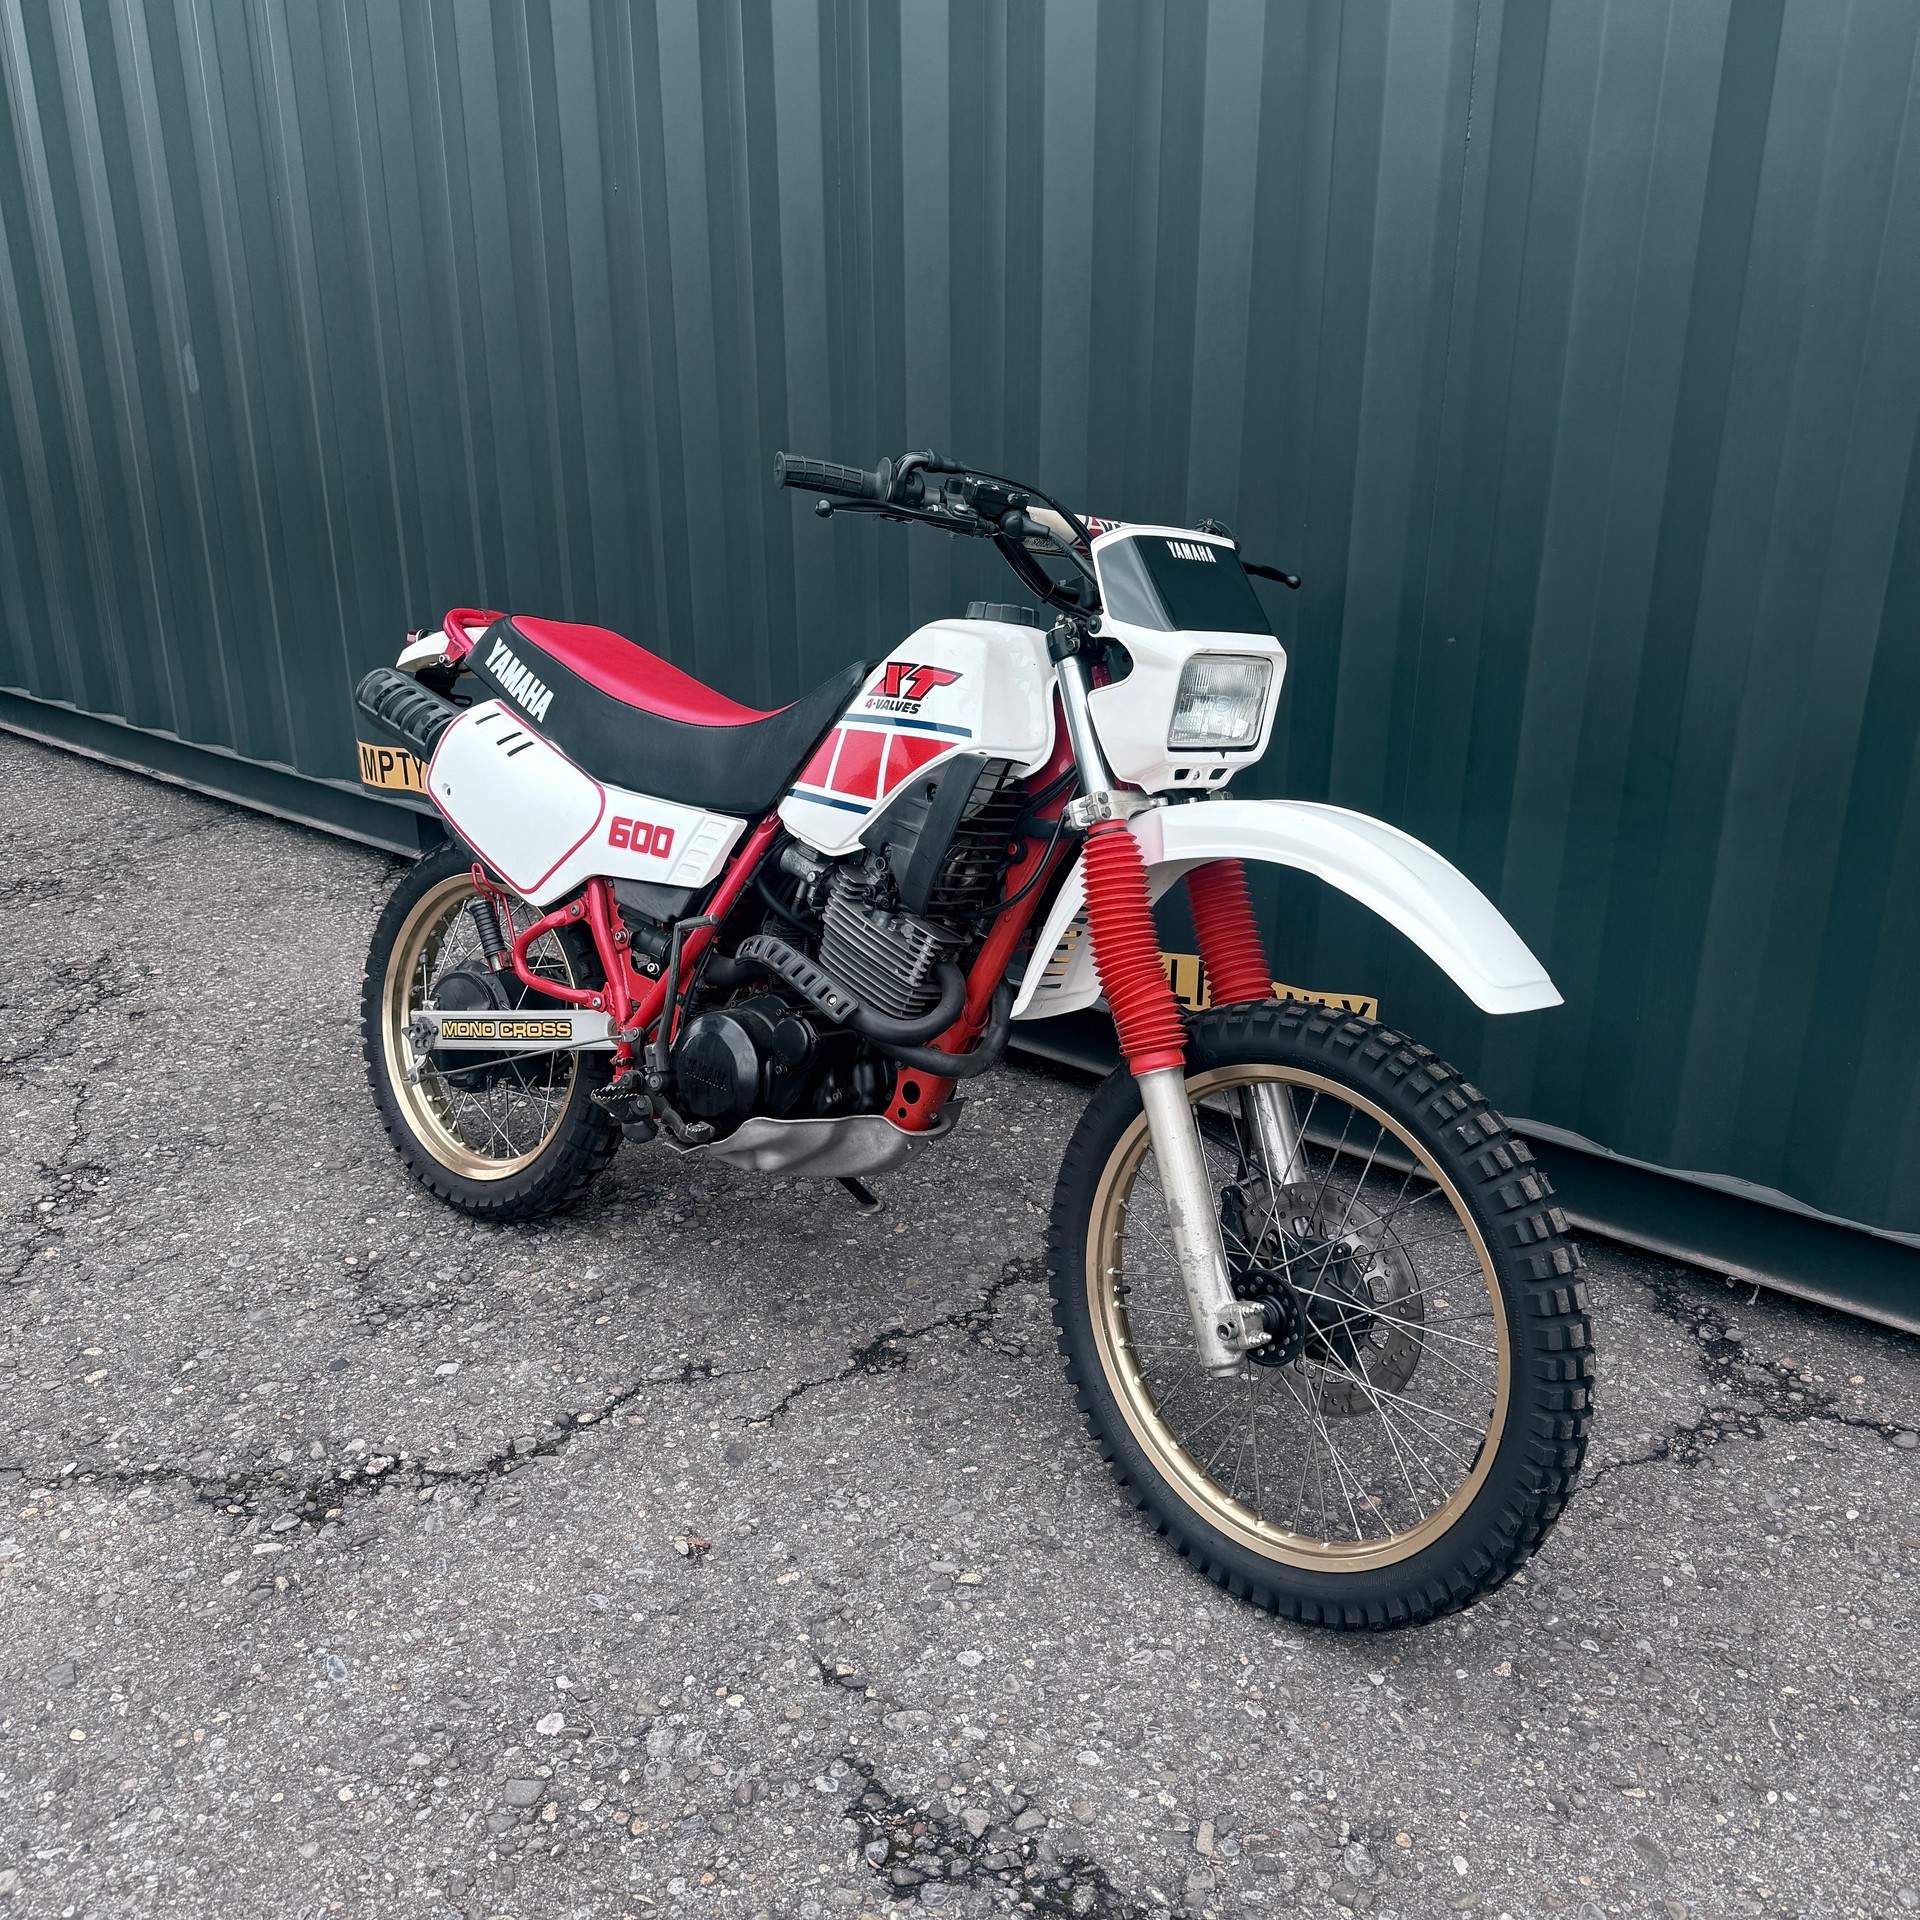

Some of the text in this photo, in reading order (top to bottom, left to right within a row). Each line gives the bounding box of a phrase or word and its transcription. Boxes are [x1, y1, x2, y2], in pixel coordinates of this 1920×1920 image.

[1166, 540, 1216, 563] YAMAHA
[484, 637, 555, 723] YAMAHA
[867, 661, 964, 701] XT
[357, 742, 423, 789] MPTY
[608, 815, 675, 859] 600
[442, 1021, 572, 1038] MONO CROSS
